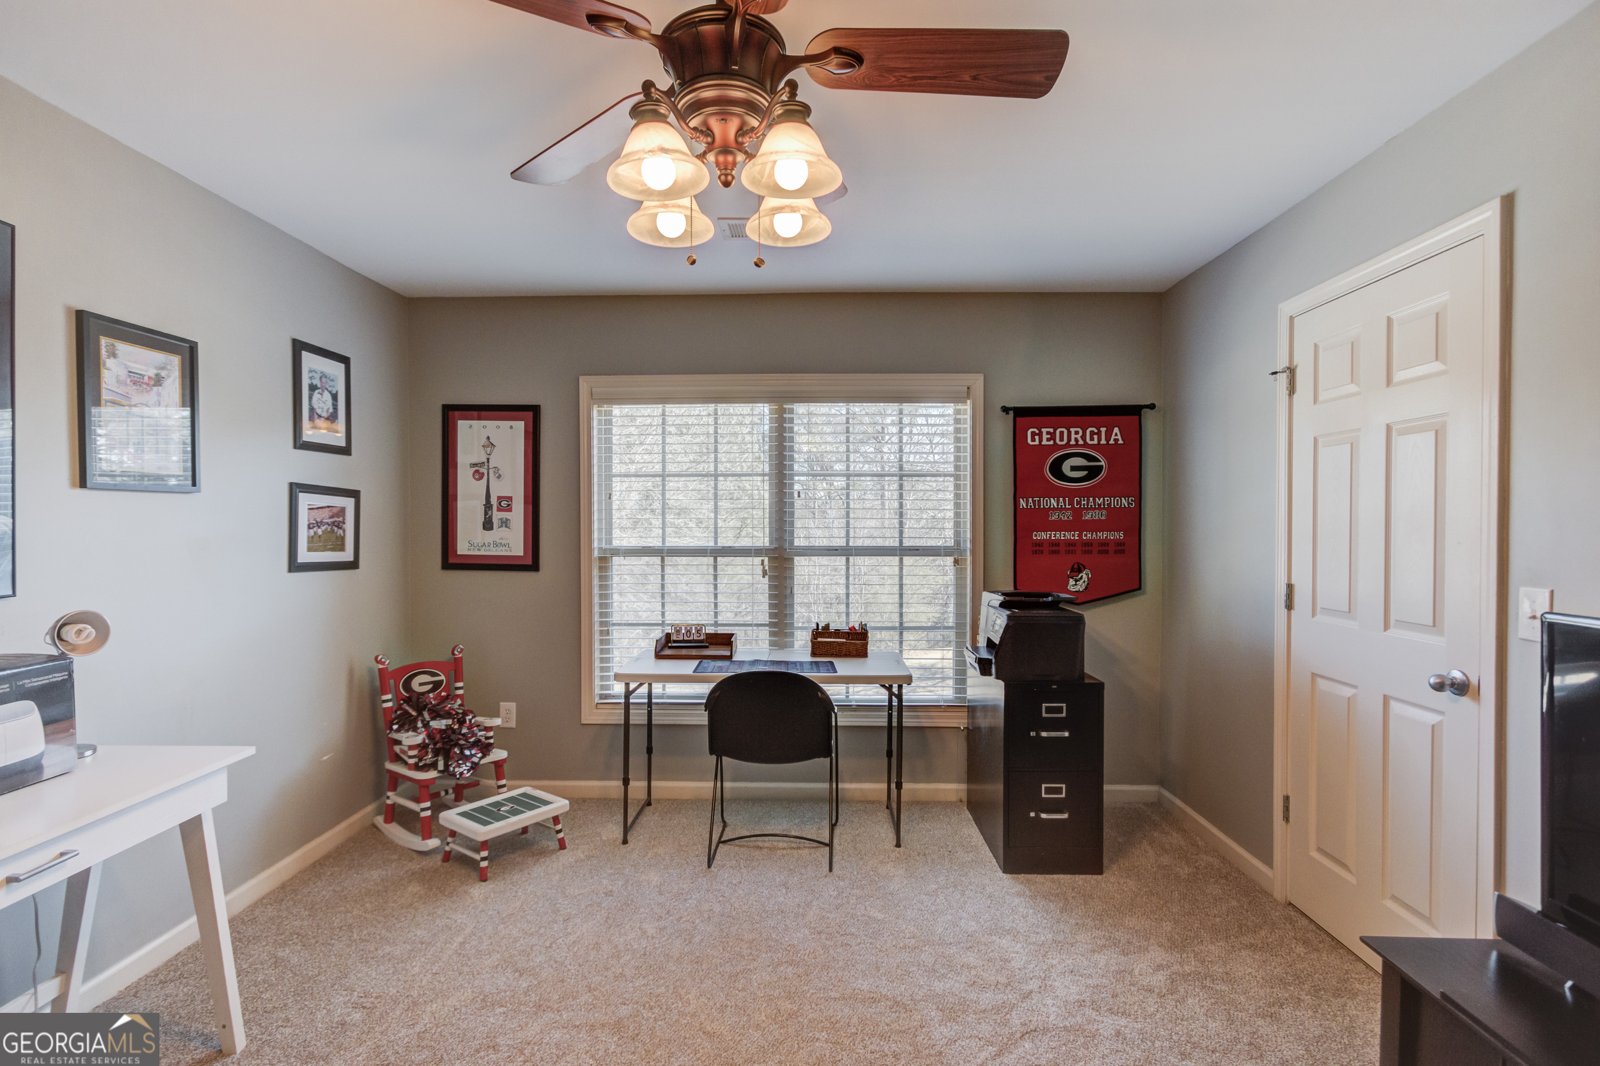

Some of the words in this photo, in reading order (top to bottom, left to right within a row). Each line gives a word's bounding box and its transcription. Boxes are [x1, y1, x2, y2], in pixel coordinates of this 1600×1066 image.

[1027, 427, 1124, 445] GEORGIA
[1048, 451, 1104, 484] G
[1019, 498, 1072, 509] NATIONAL
[1073, 497, 1135, 508] CHAMPIONS
[1032, 531, 1080, 540] CONFERENCE
[1082, 531, 1125, 540] CHAMPIONS
